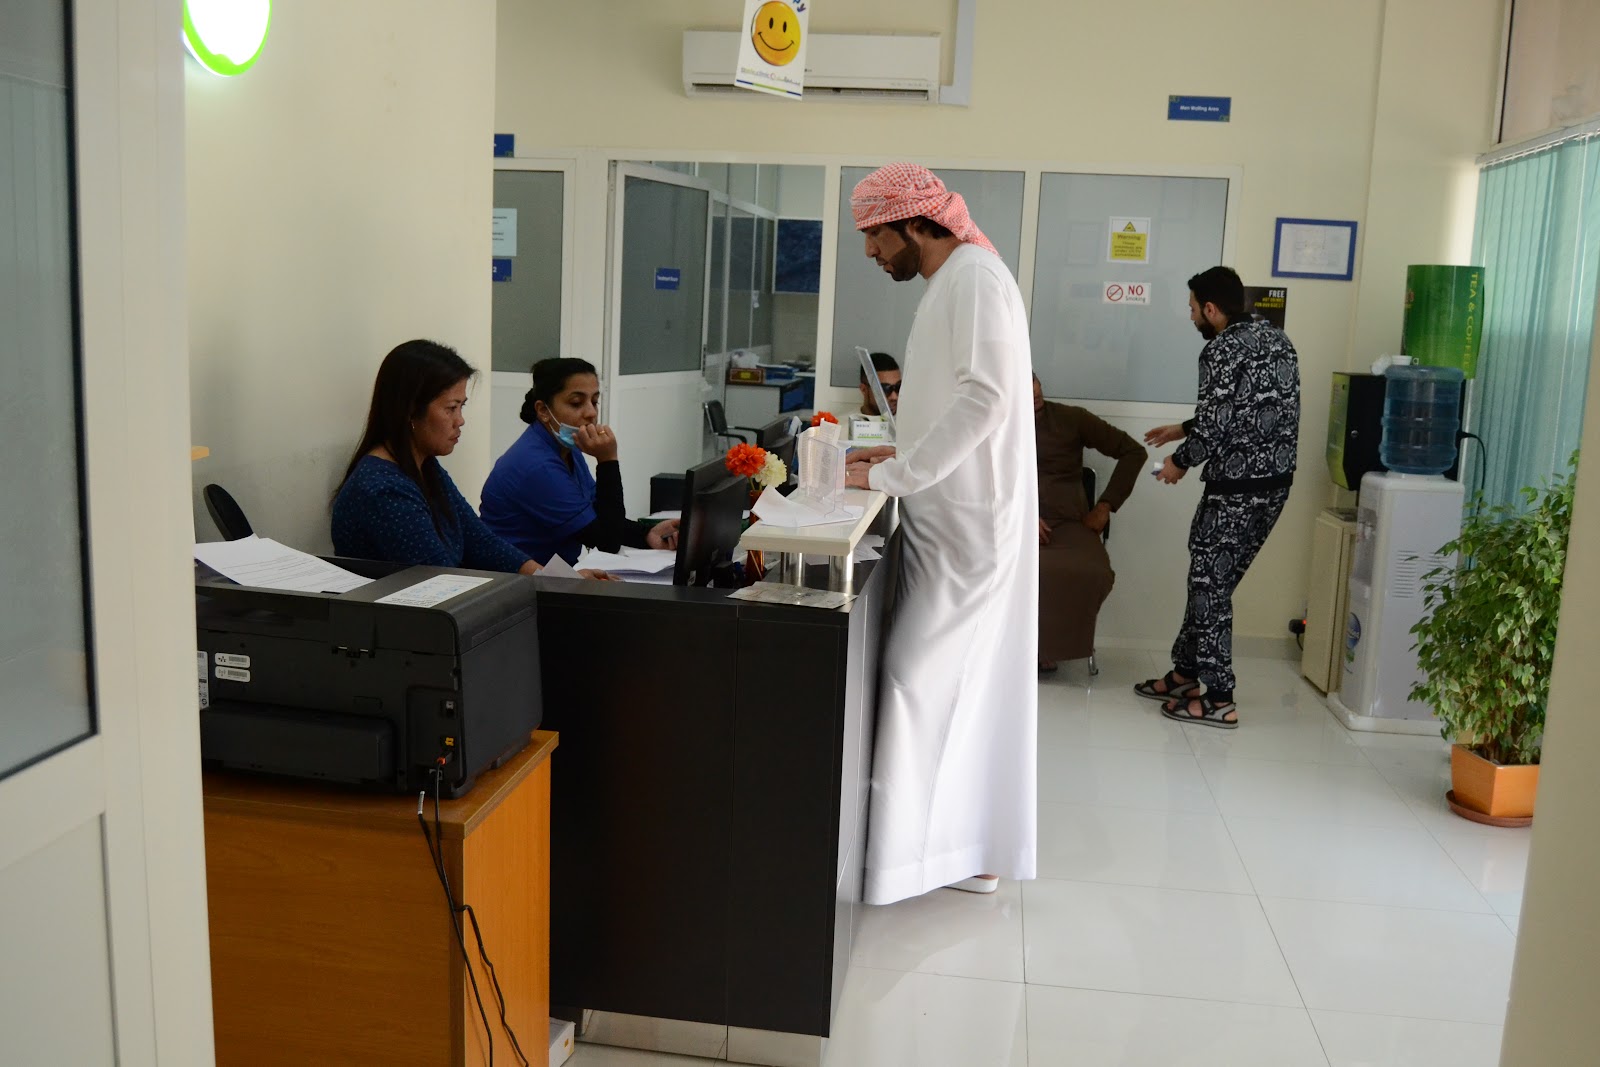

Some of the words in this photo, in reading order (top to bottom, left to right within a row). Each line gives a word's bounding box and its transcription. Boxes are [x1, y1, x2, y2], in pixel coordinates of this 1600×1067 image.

[1128, 284, 1144, 296] NO
[1469, 272, 1479, 298] TEA
[1126, 295, 1146, 304] Smoking
[1468, 302, 1476, 312] &
